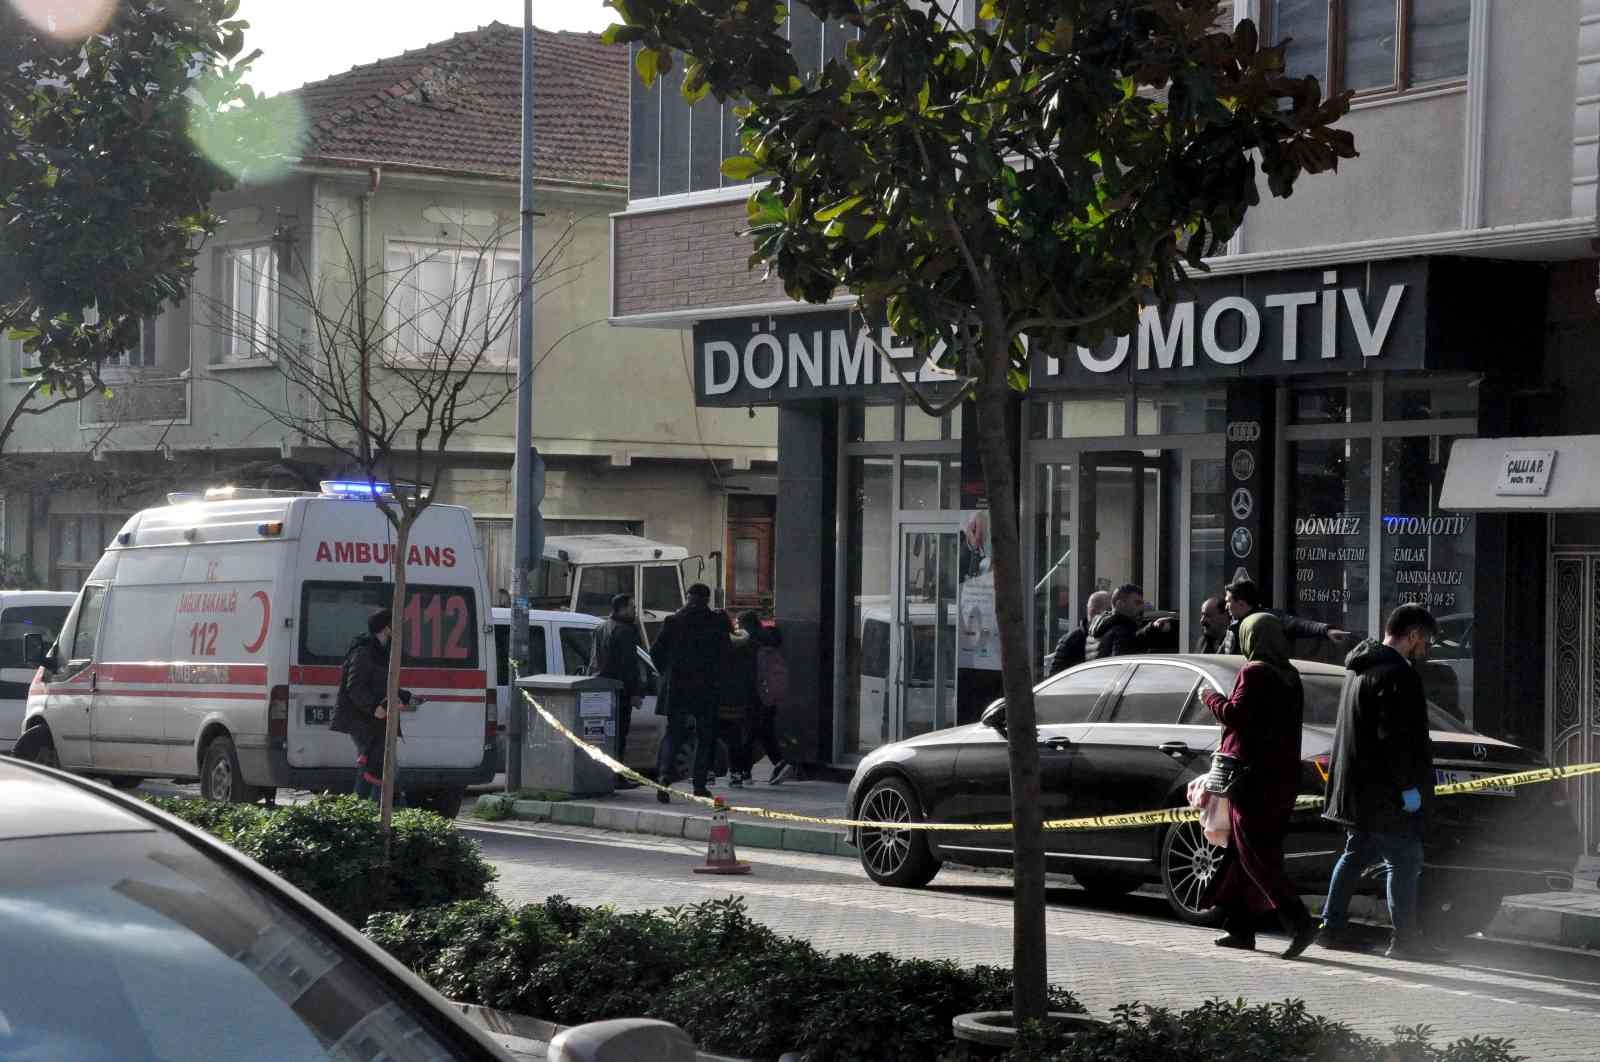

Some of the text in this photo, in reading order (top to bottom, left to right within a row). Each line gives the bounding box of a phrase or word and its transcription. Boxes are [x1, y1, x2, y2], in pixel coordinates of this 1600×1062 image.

[703, 270, 1406, 395] DÖNMEZ OMOTİV
[1295, 513, 1470, 536] DÖNMEZ OTOMOTİV
[1394, 548, 1426, 562] EMLAK
[1297, 568, 1314, 583] OTO
[403, 592, 469, 659] 112
[191, 621, 219, 656] 112
[312, 708, 324, 721] 16
